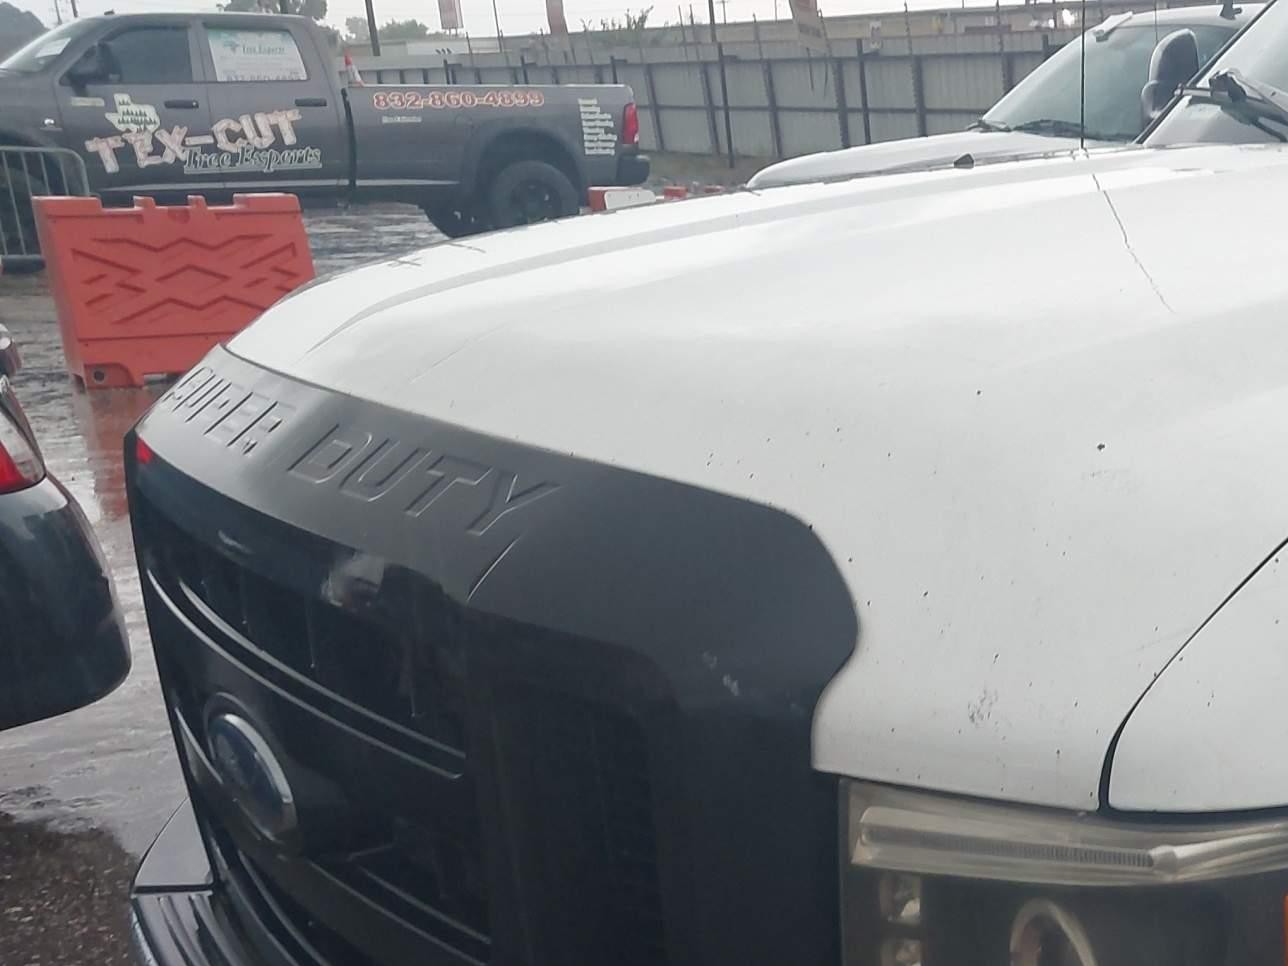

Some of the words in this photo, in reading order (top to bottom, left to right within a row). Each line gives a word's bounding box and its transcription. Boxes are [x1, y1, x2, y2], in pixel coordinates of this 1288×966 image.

[373, 90, 545, 109] 832-860-4899
[84, 108, 303, 174] TEX-CUT
[184, 146, 232, 168] Tree
[236, 143, 322, 172] Experts
[287, 422, 562, 538] DUTY
